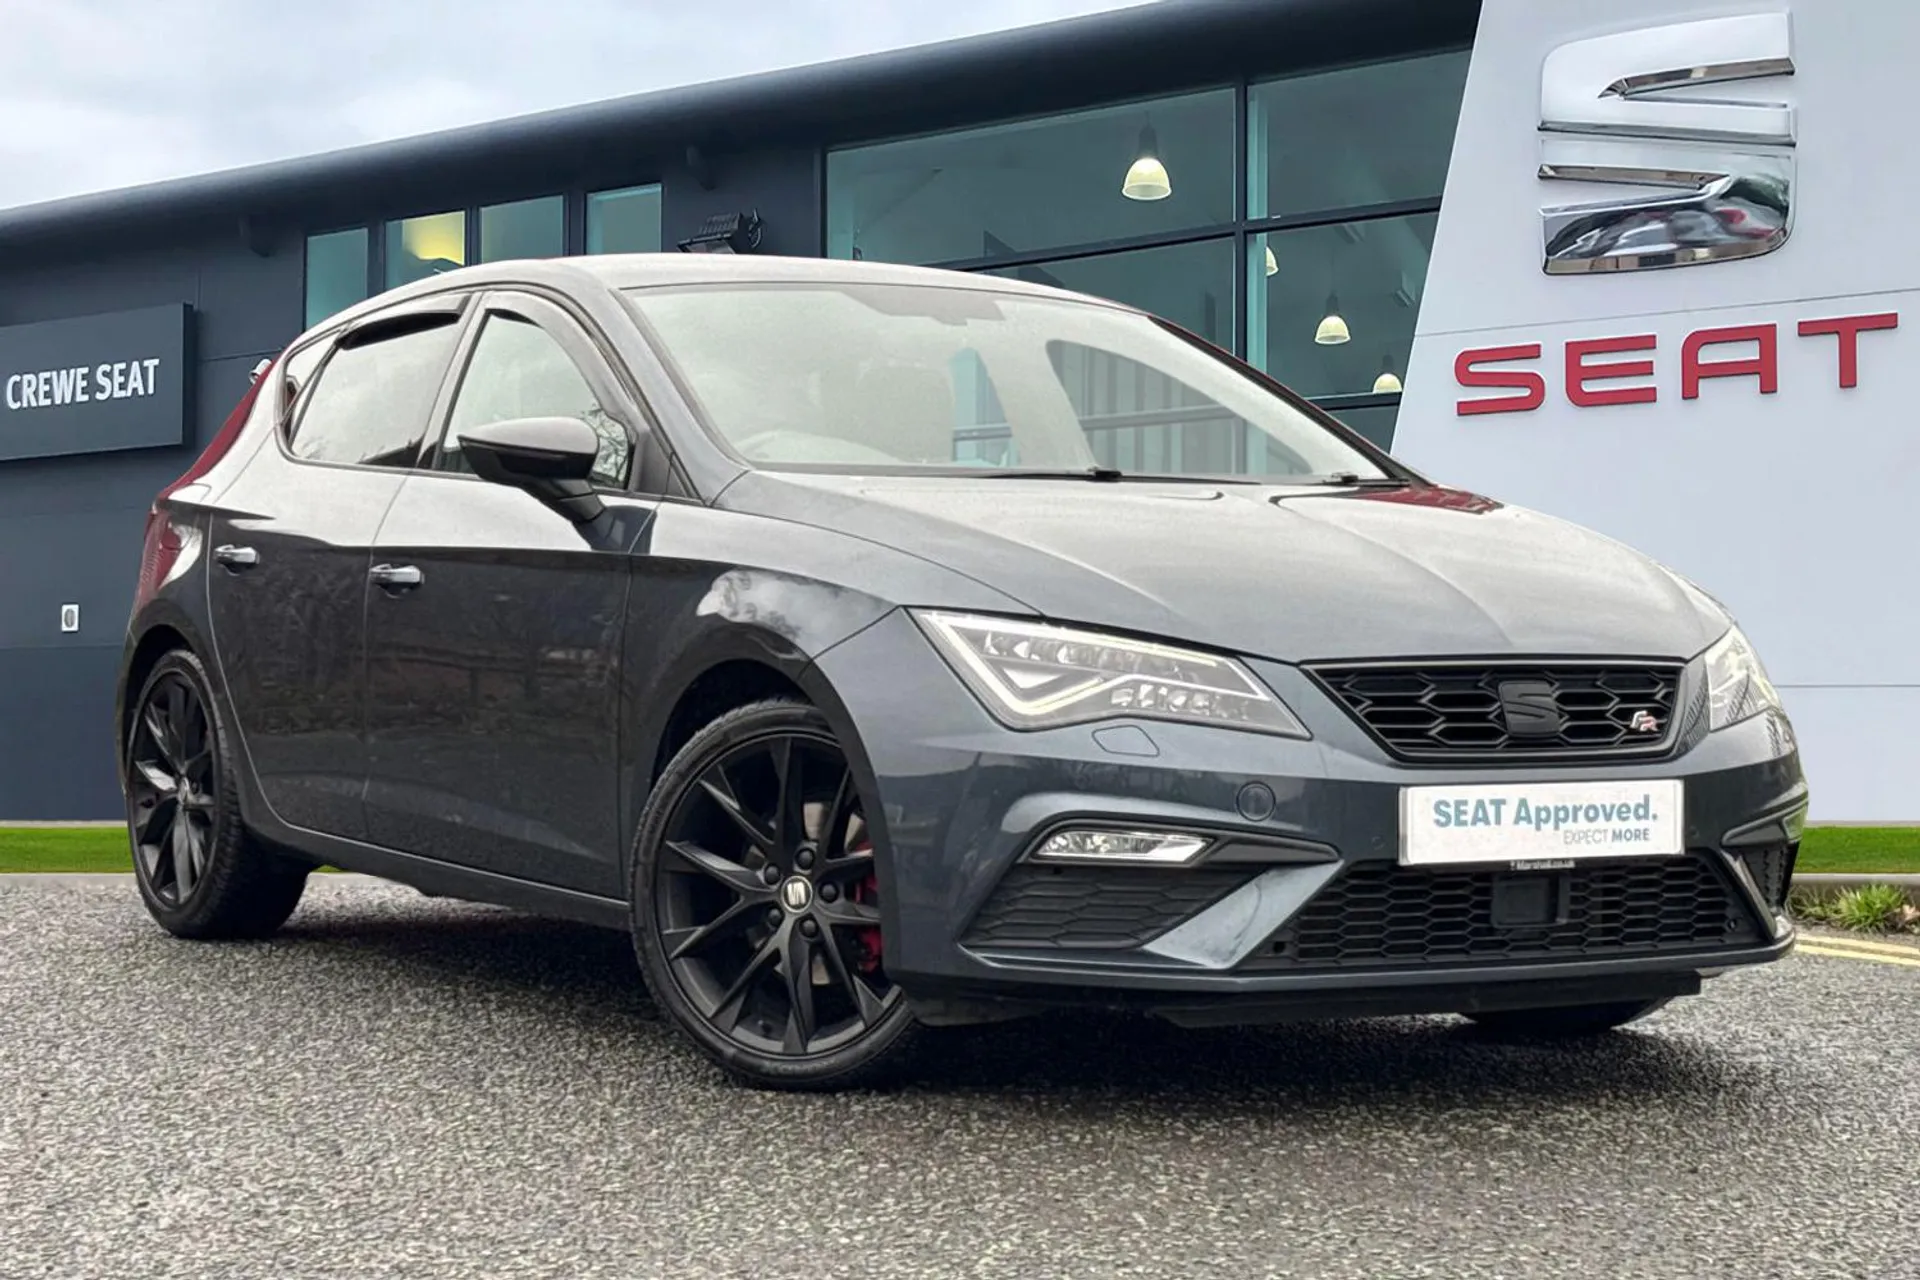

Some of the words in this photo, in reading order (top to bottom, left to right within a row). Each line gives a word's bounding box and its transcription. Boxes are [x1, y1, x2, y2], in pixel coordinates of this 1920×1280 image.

[6, 366, 90, 410] CREWE
[94, 358, 160, 401] SEAT
[1454, 313, 1898, 416] SEAT
[1433, 798, 1506, 828] SEAT
[1513, 795, 1658, 831] Approved.
[1563, 829, 1609, 846] EXPECT
[1611, 827, 1650, 843] MORE
